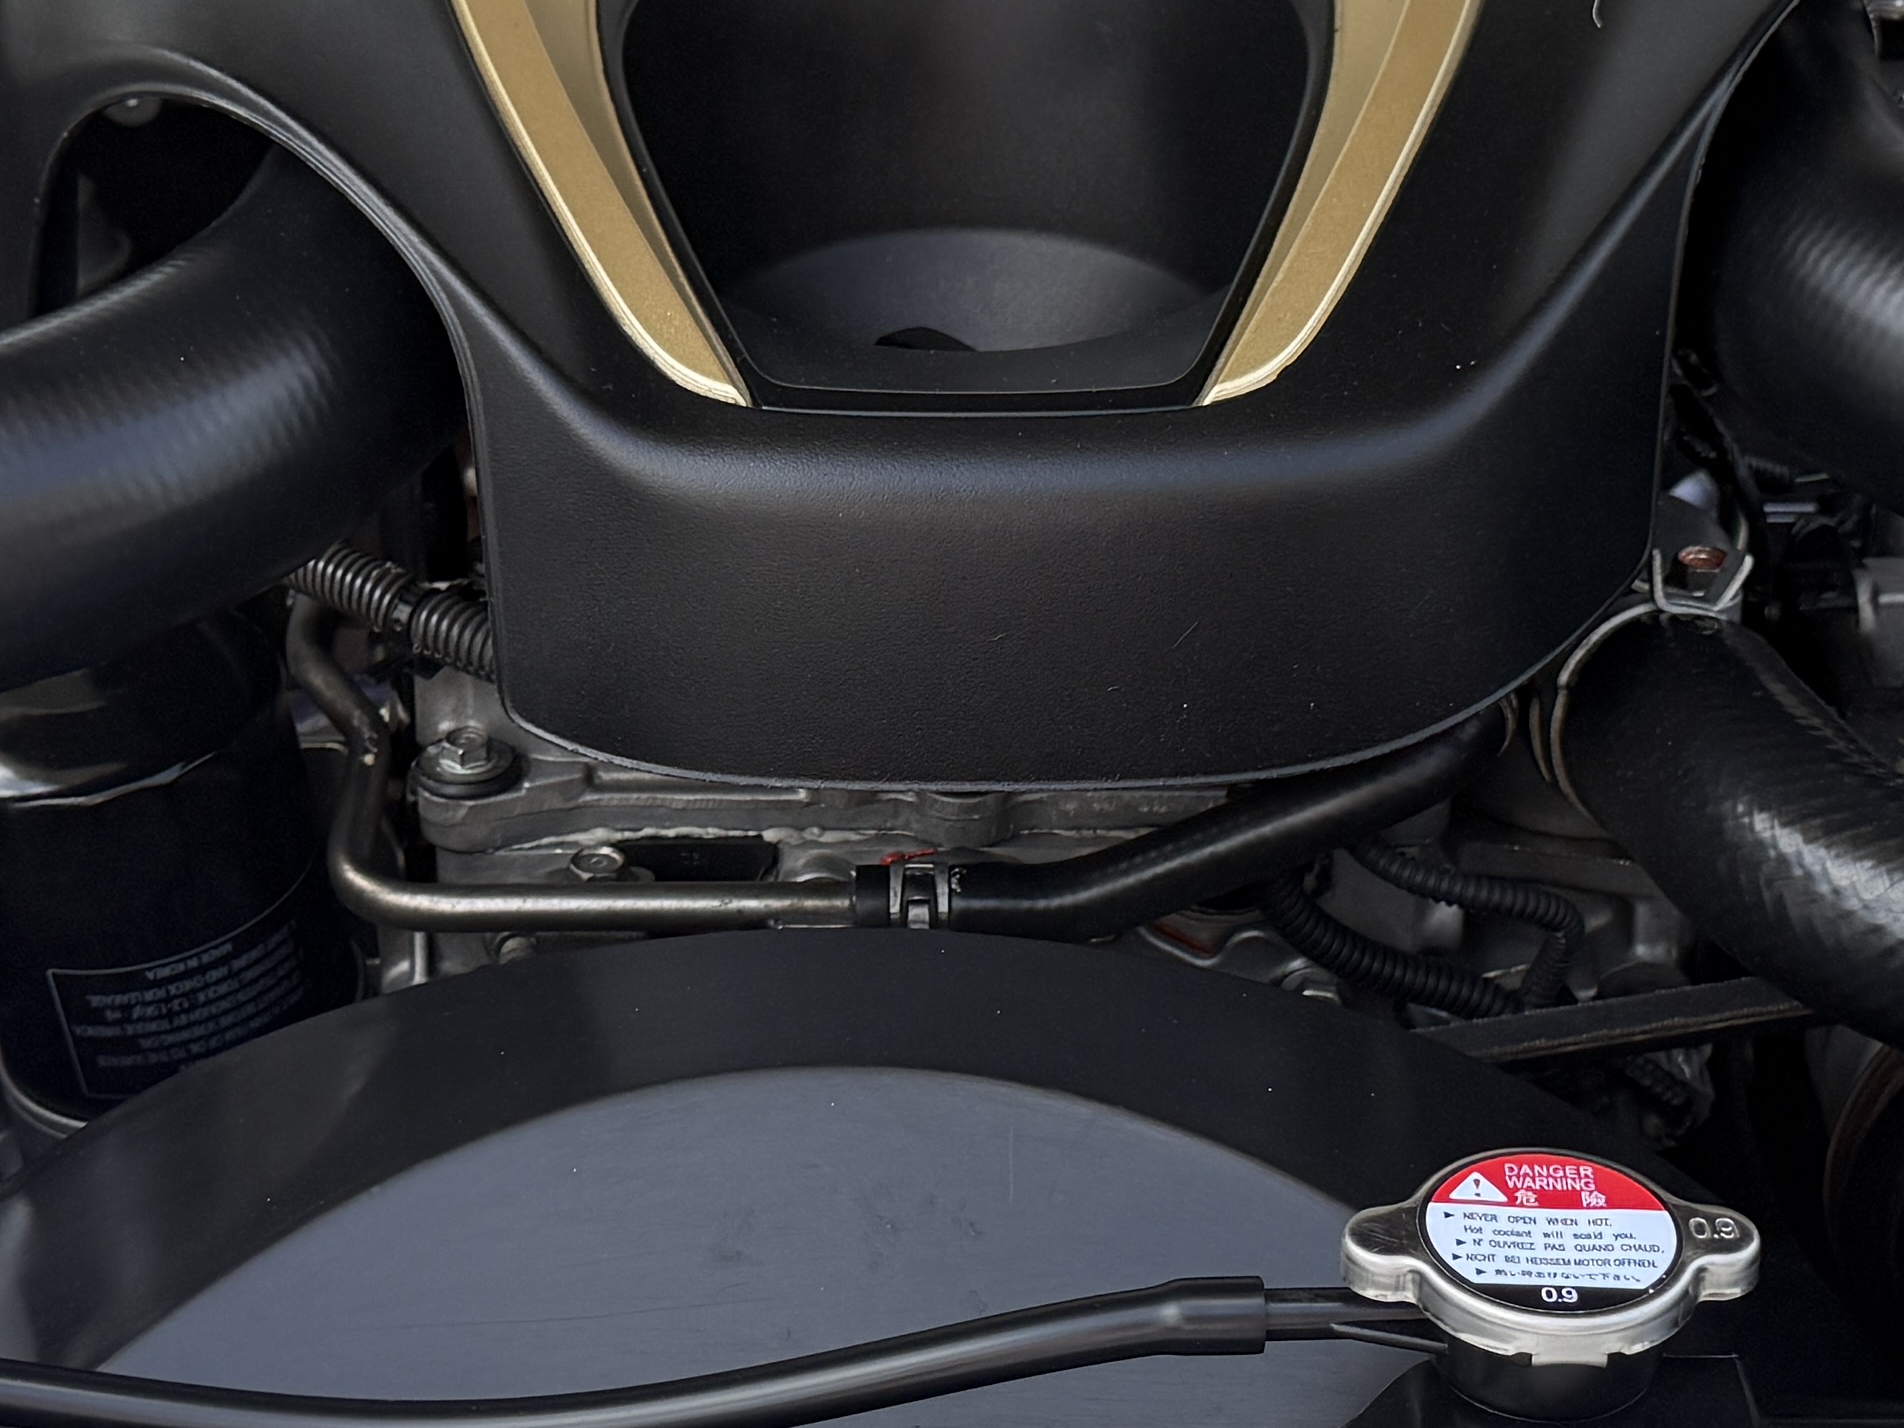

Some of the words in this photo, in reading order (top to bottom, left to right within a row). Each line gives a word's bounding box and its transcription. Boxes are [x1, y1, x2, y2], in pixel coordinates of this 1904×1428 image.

[1504, 1163, 1594, 1178] DANGER
[1505, 1175, 1596, 1191] WARNING
[1514, 1189, 1539, 1207] 危
[1463, 1211, 1498, 1224] NEVER
[1507, 1215, 1537, 1225] OPEN
[1545, 1216, 1579, 1226] WHEN
[1464, 1224, 1483, 1234] Hot
[1492, 1227, 1533, 1238] coolant
[1542, 1229, 1563, 1239] will
[1573, 1231, 1603, 1240] scald
[1612, 1232, 1637, 1241] you.
[1687, 1217, 1740, 1240] 0.9
[1488, 1239, 1536, 1251] OUVREZ
[1544, 1242, 1566, 1252] PAS
[1575, 1243, 1615, 1253] QUAND
[1620, 1243, 1665, 1254] CHAUD.
[1466, 1253, 1498, 1263] NICHT
[1573, 1258, 1613, 1268] MOTOR
[1540, 1286, 1579, 1303] 0.9
